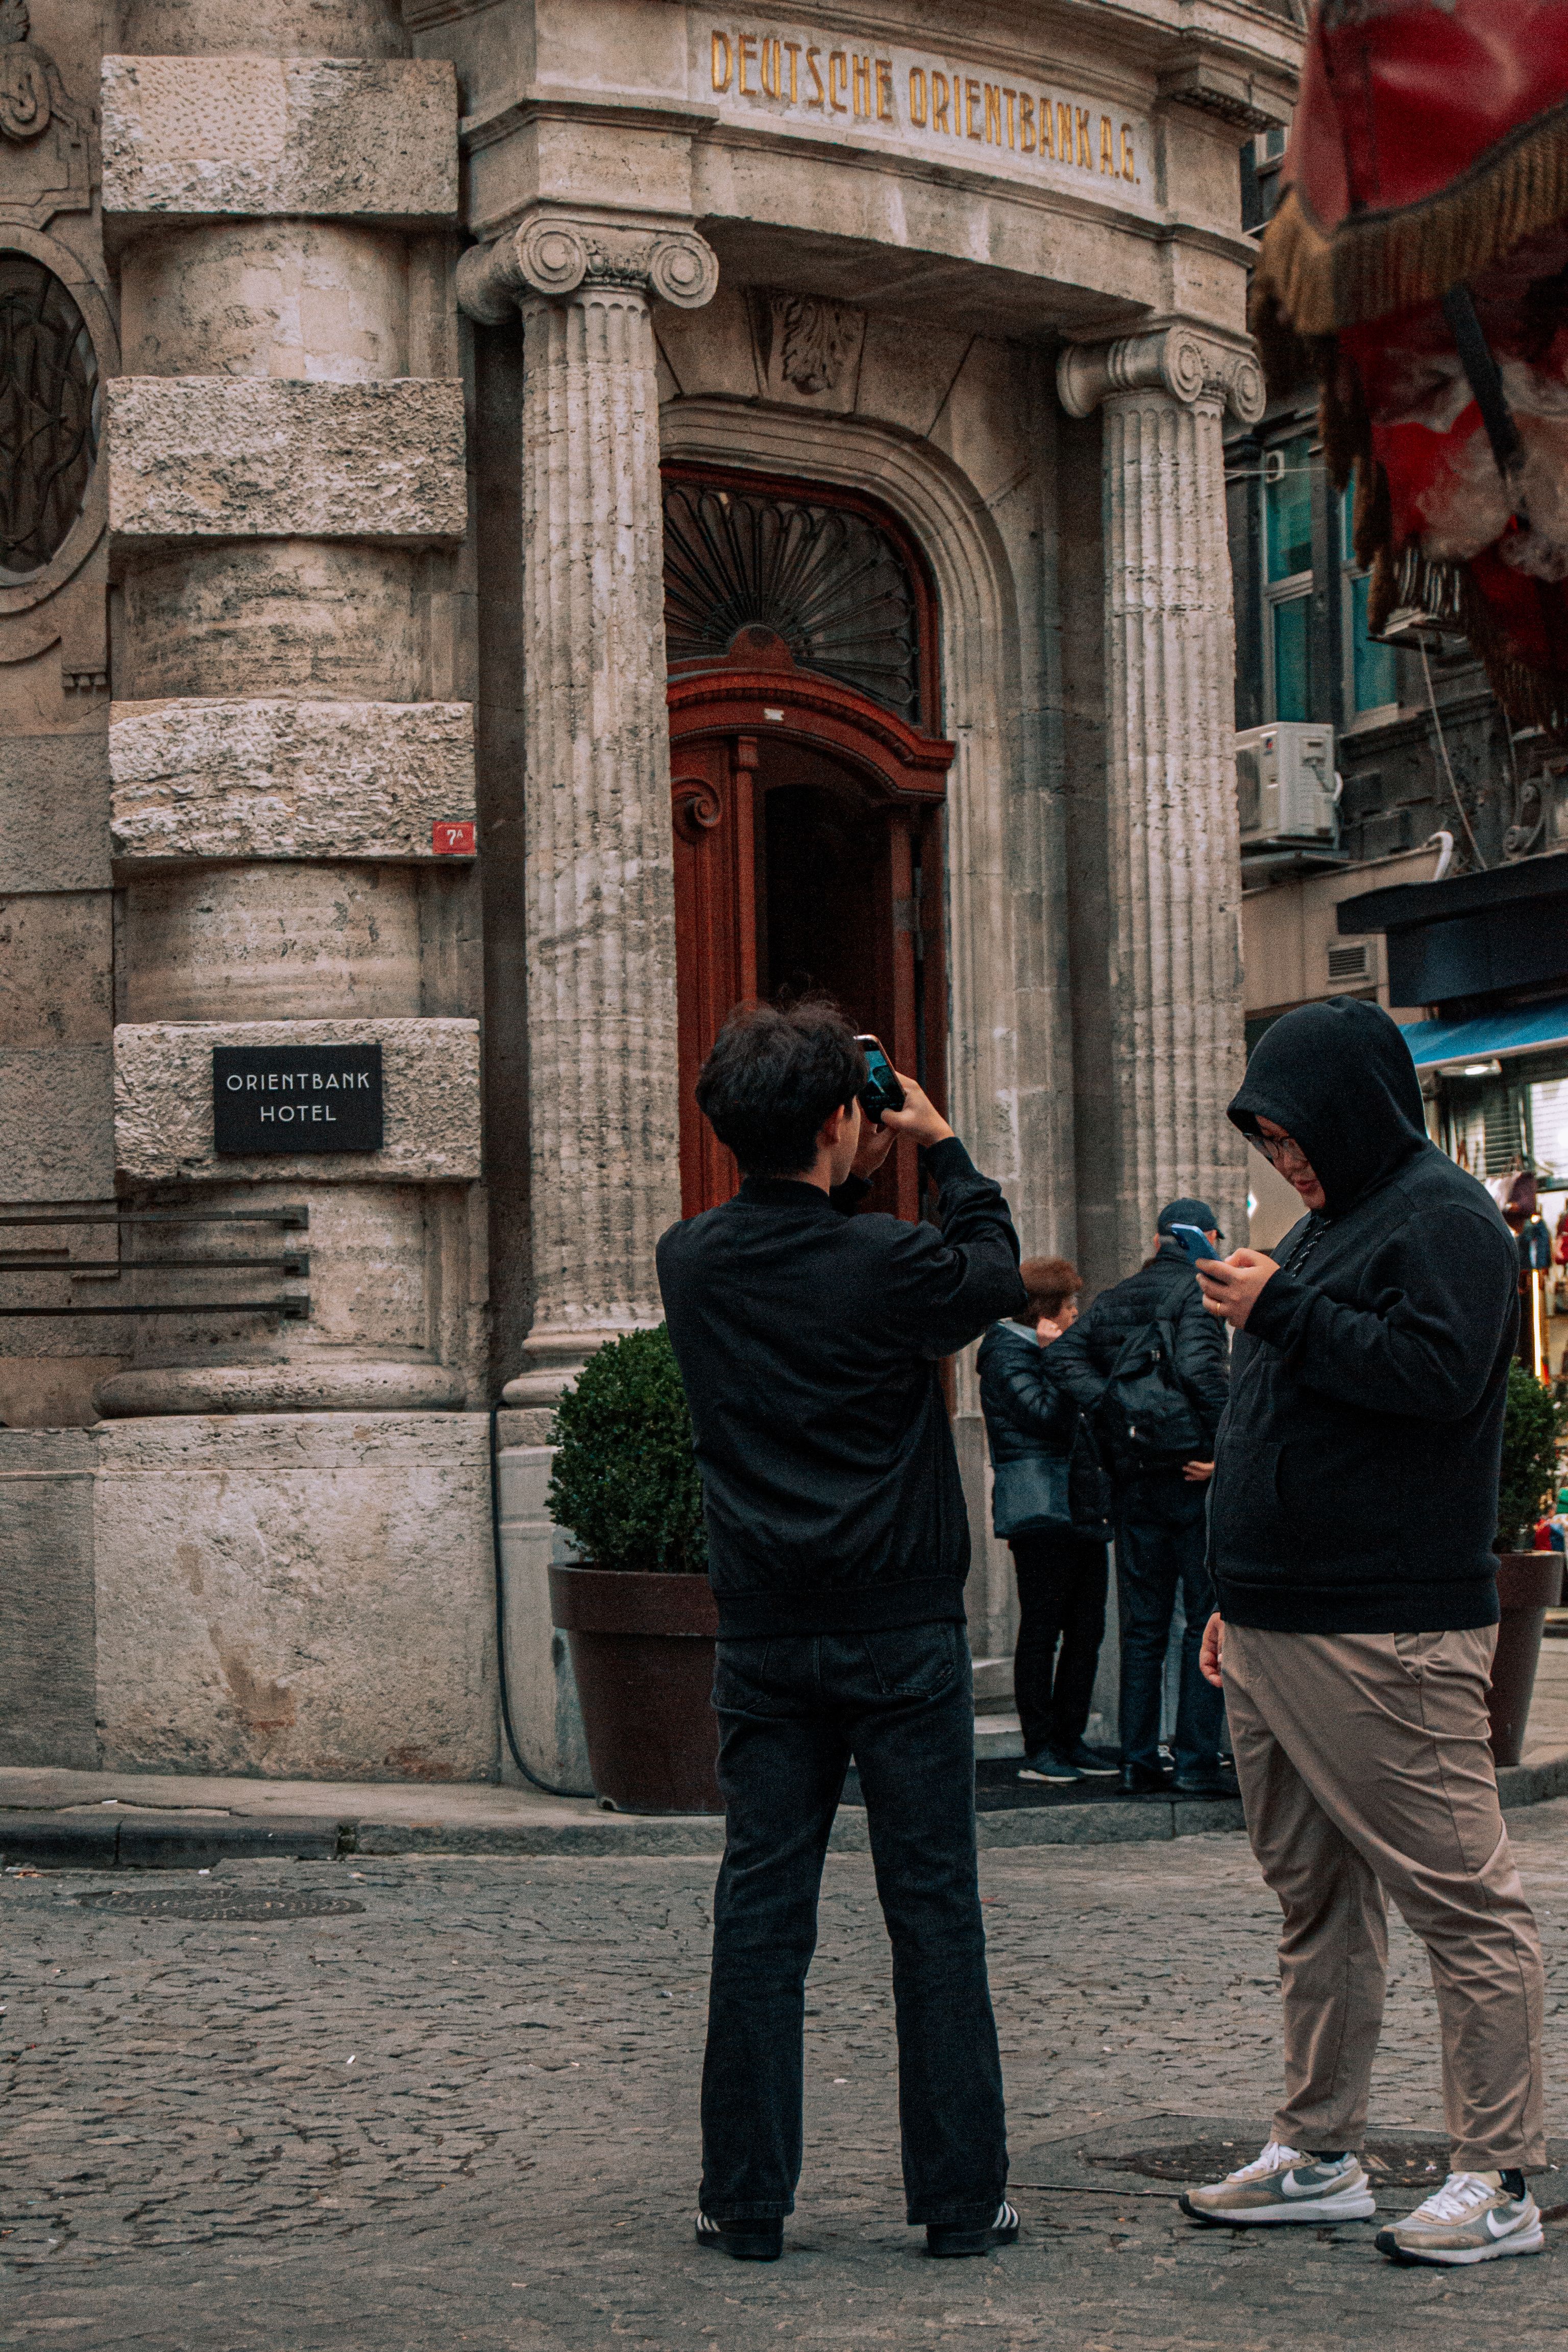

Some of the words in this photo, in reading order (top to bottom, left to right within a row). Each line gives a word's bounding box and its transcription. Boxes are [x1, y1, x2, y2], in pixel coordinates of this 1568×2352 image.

[711, 30, 893, 122] DEUTSCHE
[909, 66, 1092, 170] ORIENTBANK
[1099, 114, 1141, 184] A.G.
[446, 829, 463, 846] 7A
[227, 1072, 370, 1091] ORIENTBANK
[260, 1105, 337, 1122] HOTEL
